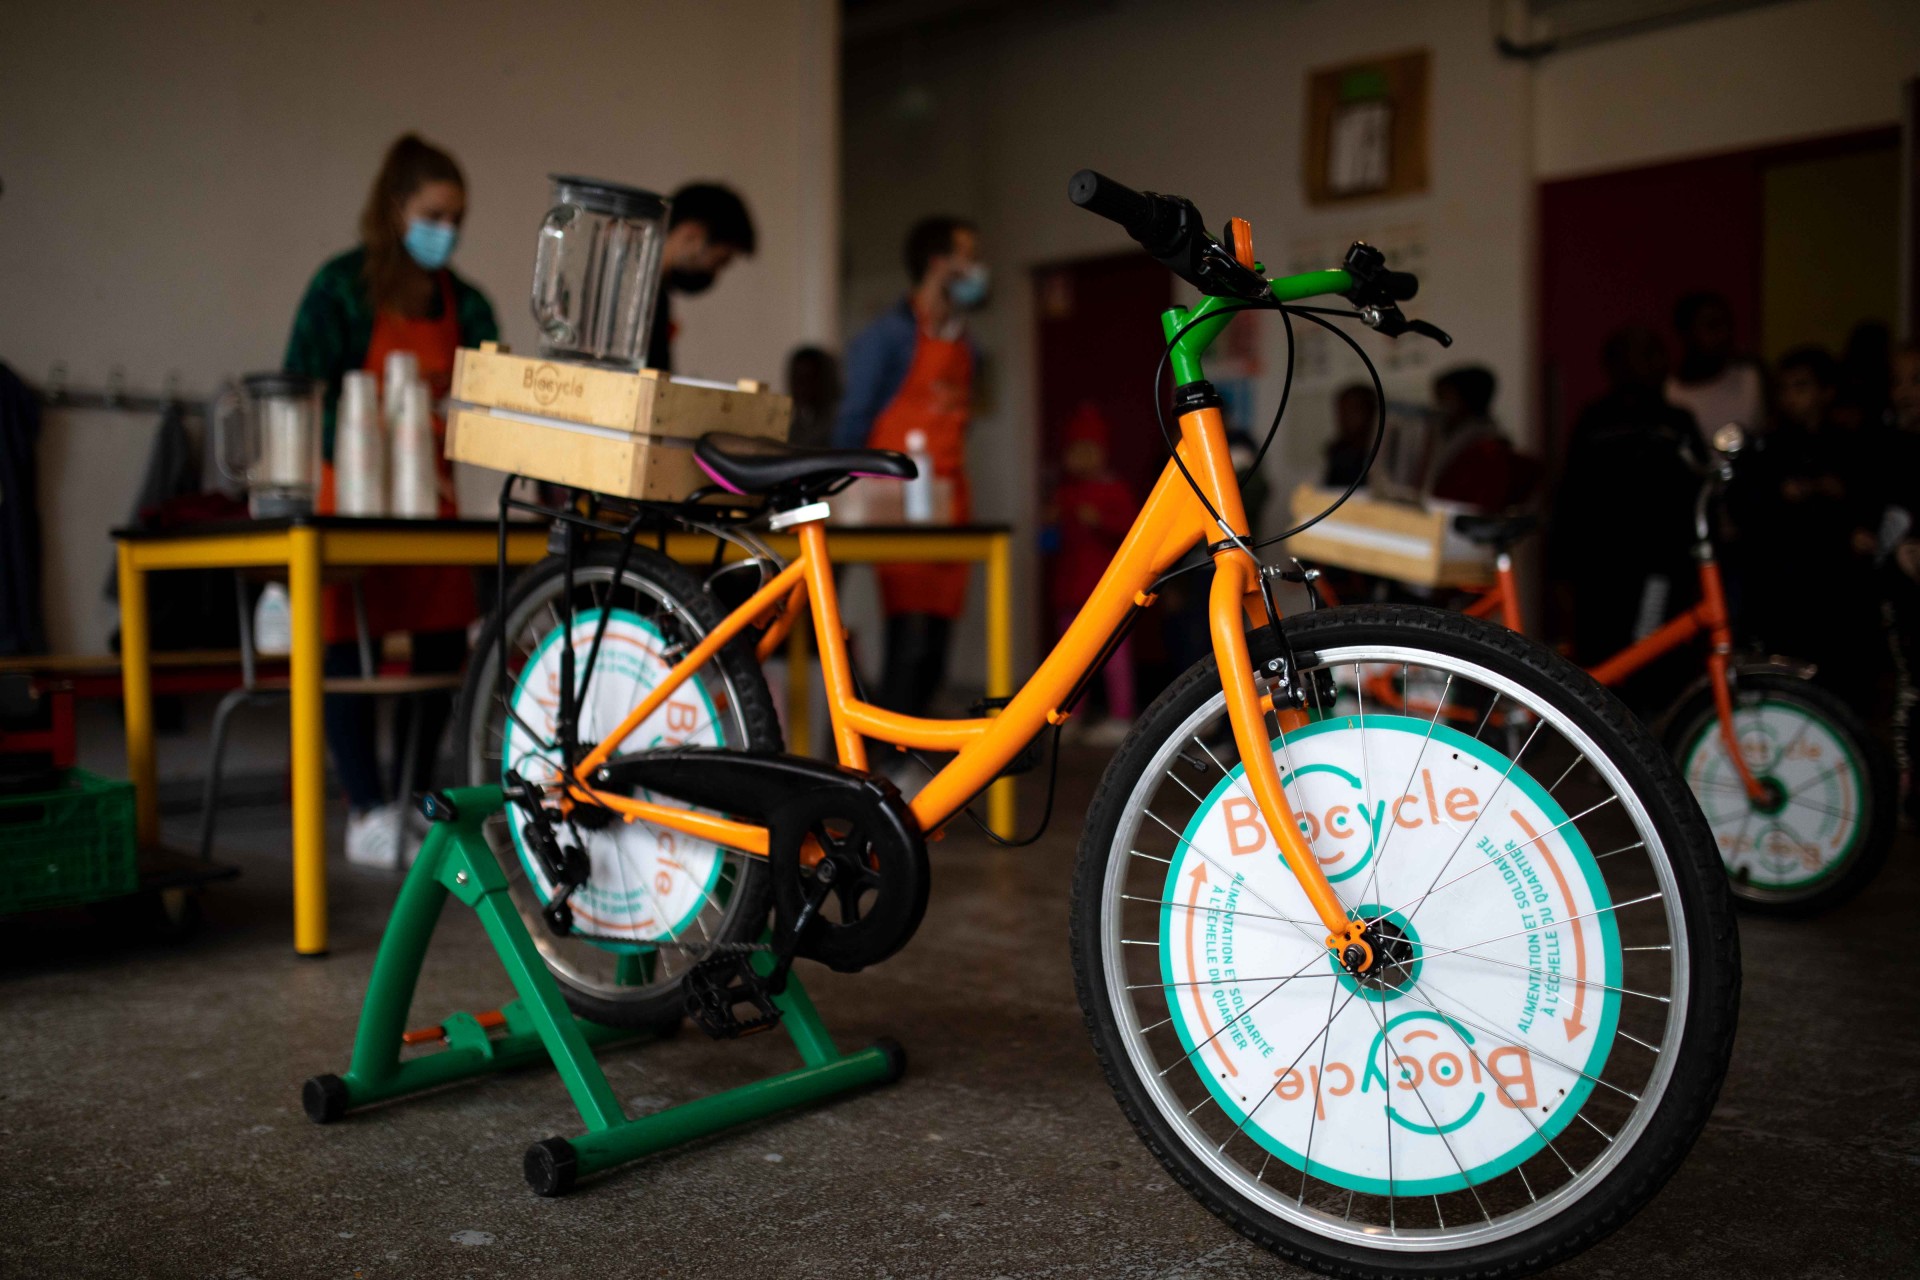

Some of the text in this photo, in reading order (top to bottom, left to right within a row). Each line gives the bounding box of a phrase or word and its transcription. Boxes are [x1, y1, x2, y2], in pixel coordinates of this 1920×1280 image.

[1221, 765, 1480, 864] Bocycle
[1211, 884, 1226, 895] À
[1504, 839, 1549, 904] QUARTIER
[1521, 913, 1537, 931] ET
[1208, 968, 1221, 987] DU
[1221, 871, 1275, 1059] ALIMENTATION ET SOLDARITÉ
[1517, 934, 1541, 1034] ALIMENTATION
[1544, 930, 1561, 1004] L'ÉCHELLE
[1212, 988, 1248, 1051] QUARTIER
[1539, 1006, 1556, 1018] À
[1273, 1040, 1538, 1123] Biocycle
